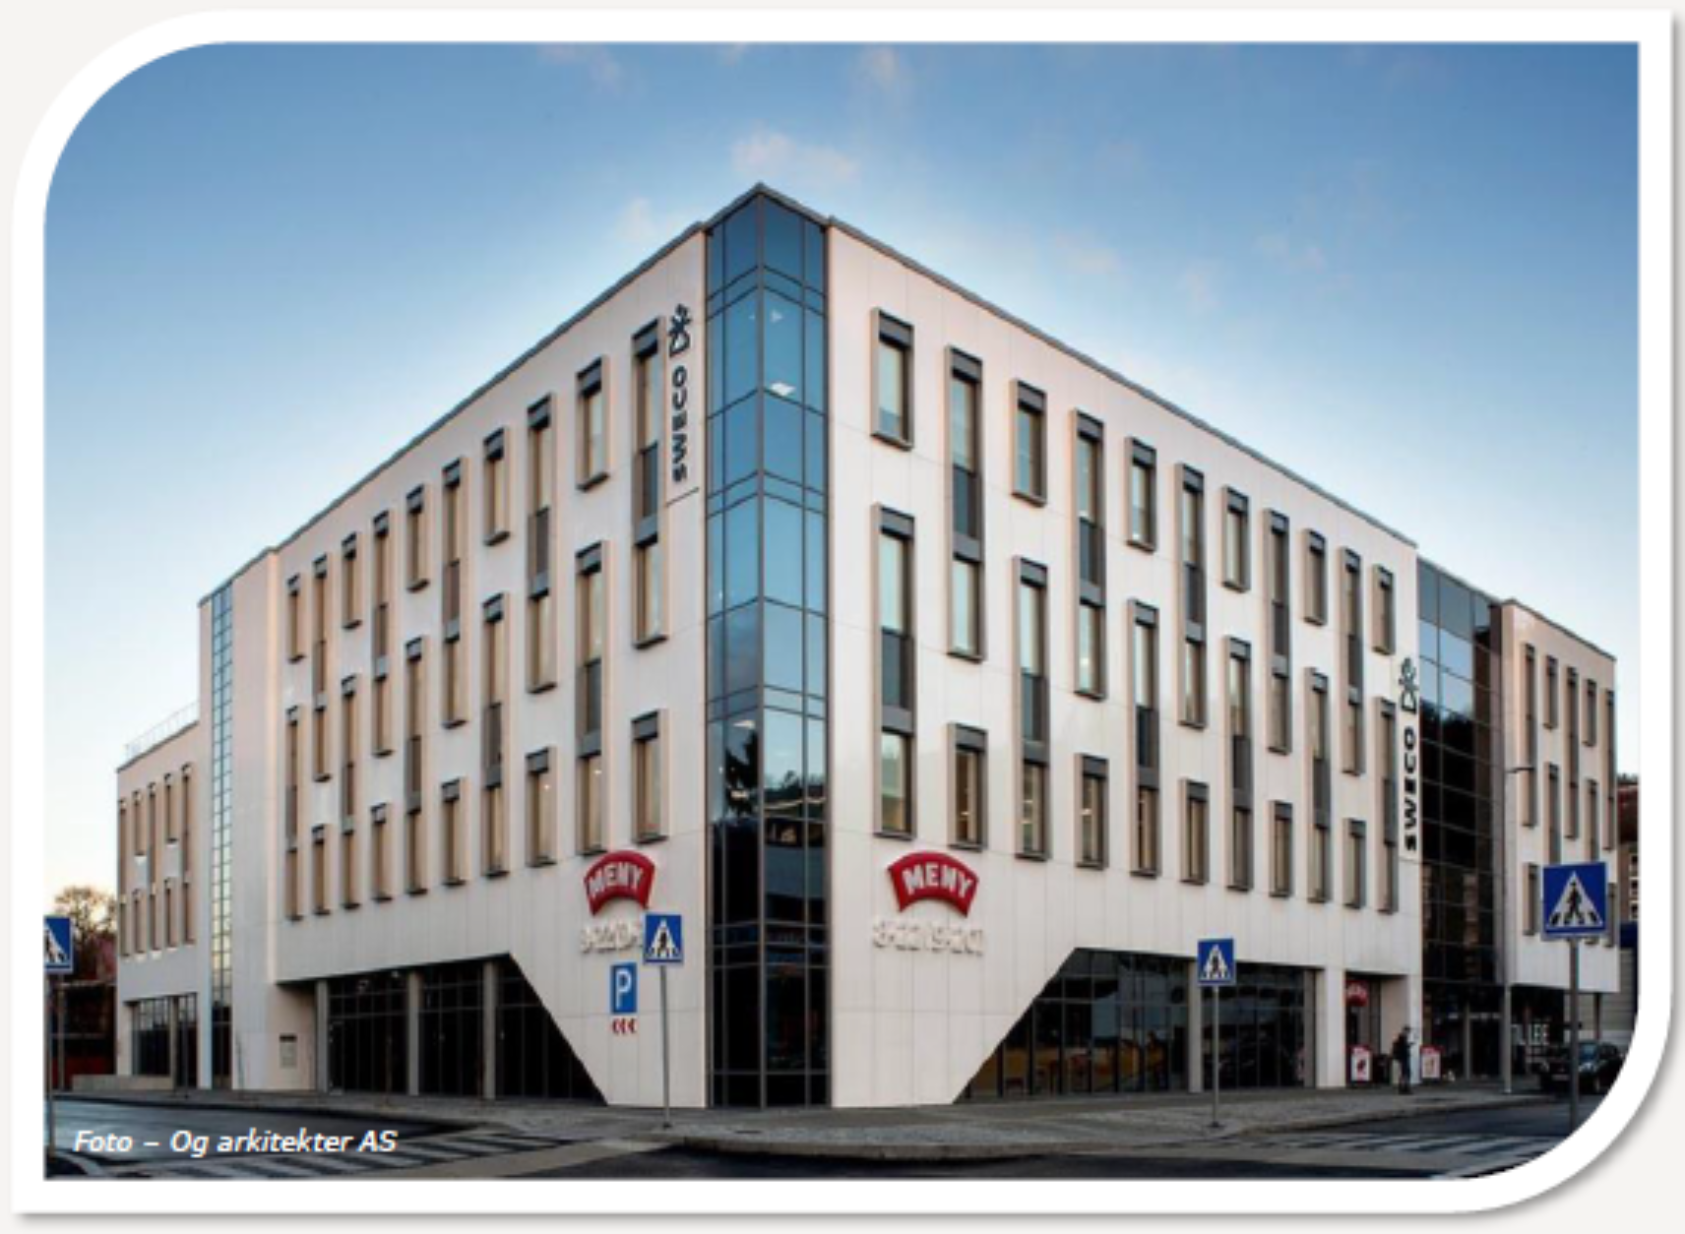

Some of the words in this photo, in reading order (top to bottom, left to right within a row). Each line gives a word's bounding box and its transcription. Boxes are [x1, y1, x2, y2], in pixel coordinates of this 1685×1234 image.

[672, 365, 687, 482] SWECO
[1404, 726, 1417, 851] SWECO
[588, 860, 644, 898] MENY
[901, 861, 974, 898] MENY
[615, 968, 632, 1010] P
